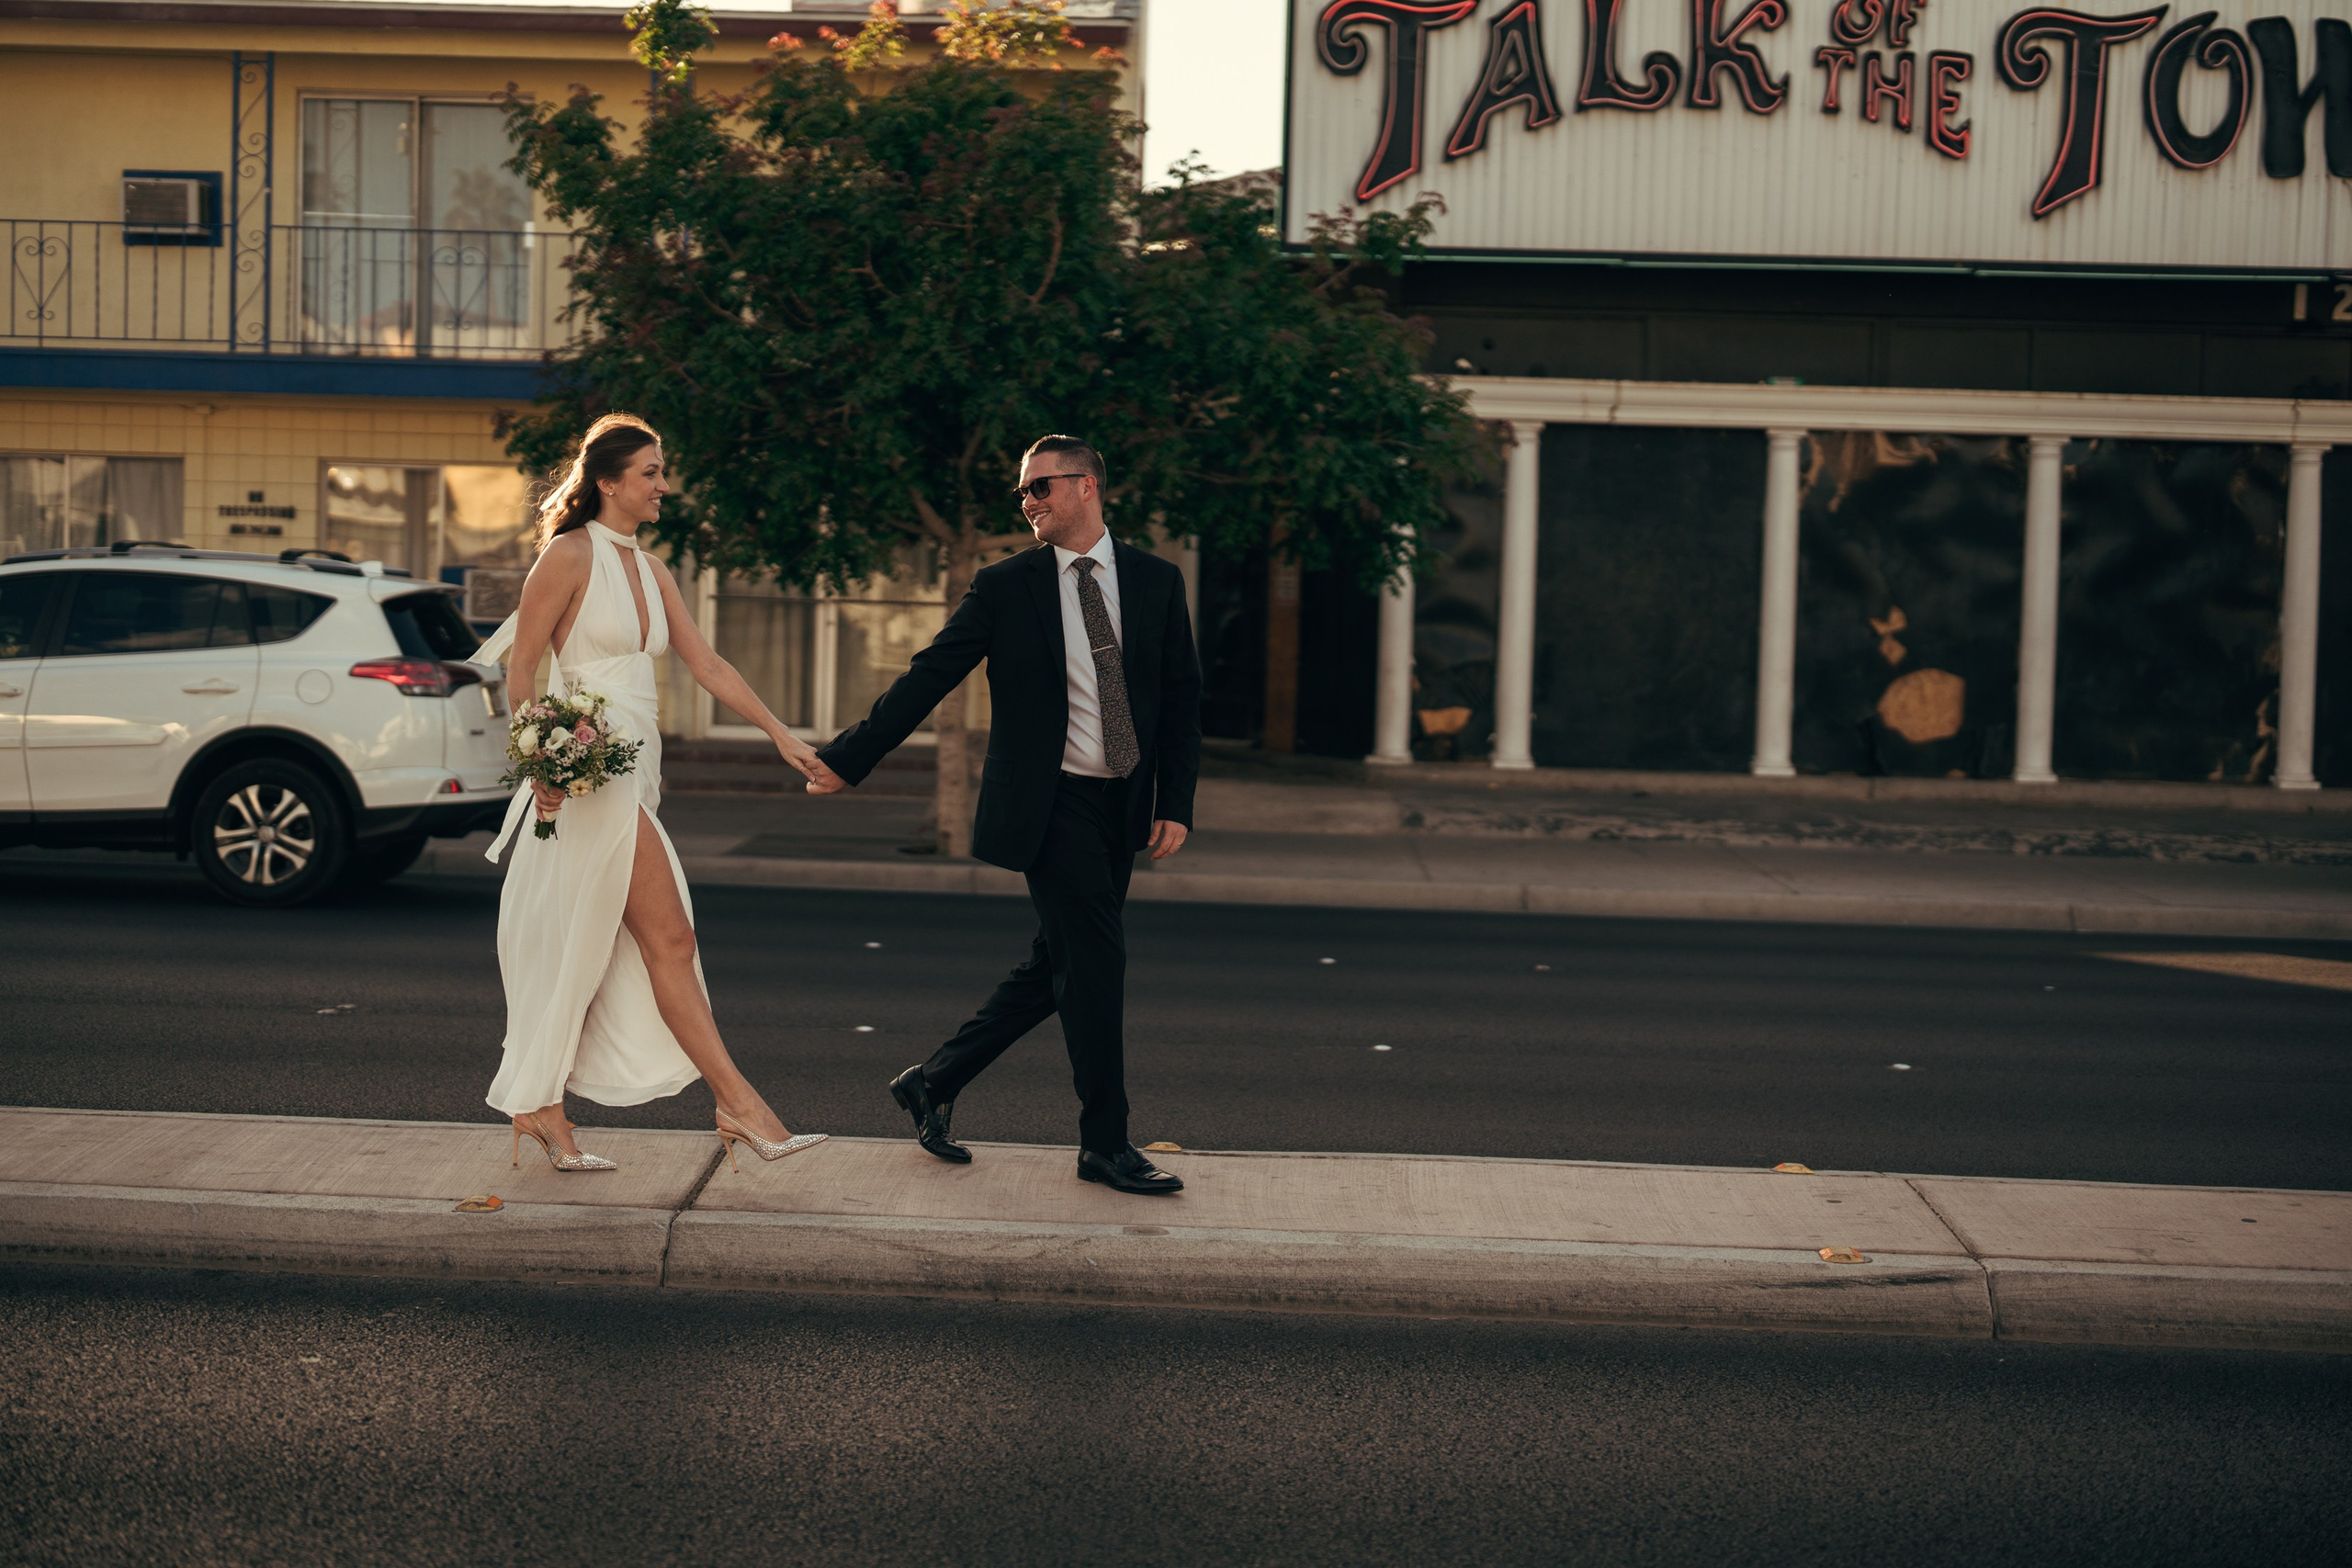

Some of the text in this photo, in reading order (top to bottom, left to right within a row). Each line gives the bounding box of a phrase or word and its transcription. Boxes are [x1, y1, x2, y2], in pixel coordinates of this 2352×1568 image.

[1830, 0, 1927, 48] OF
[1317, 0, 1791, 204] TALK
[1814, 45, 1973, 159] THE
[219, 504, 296, 520] TRESPASS
